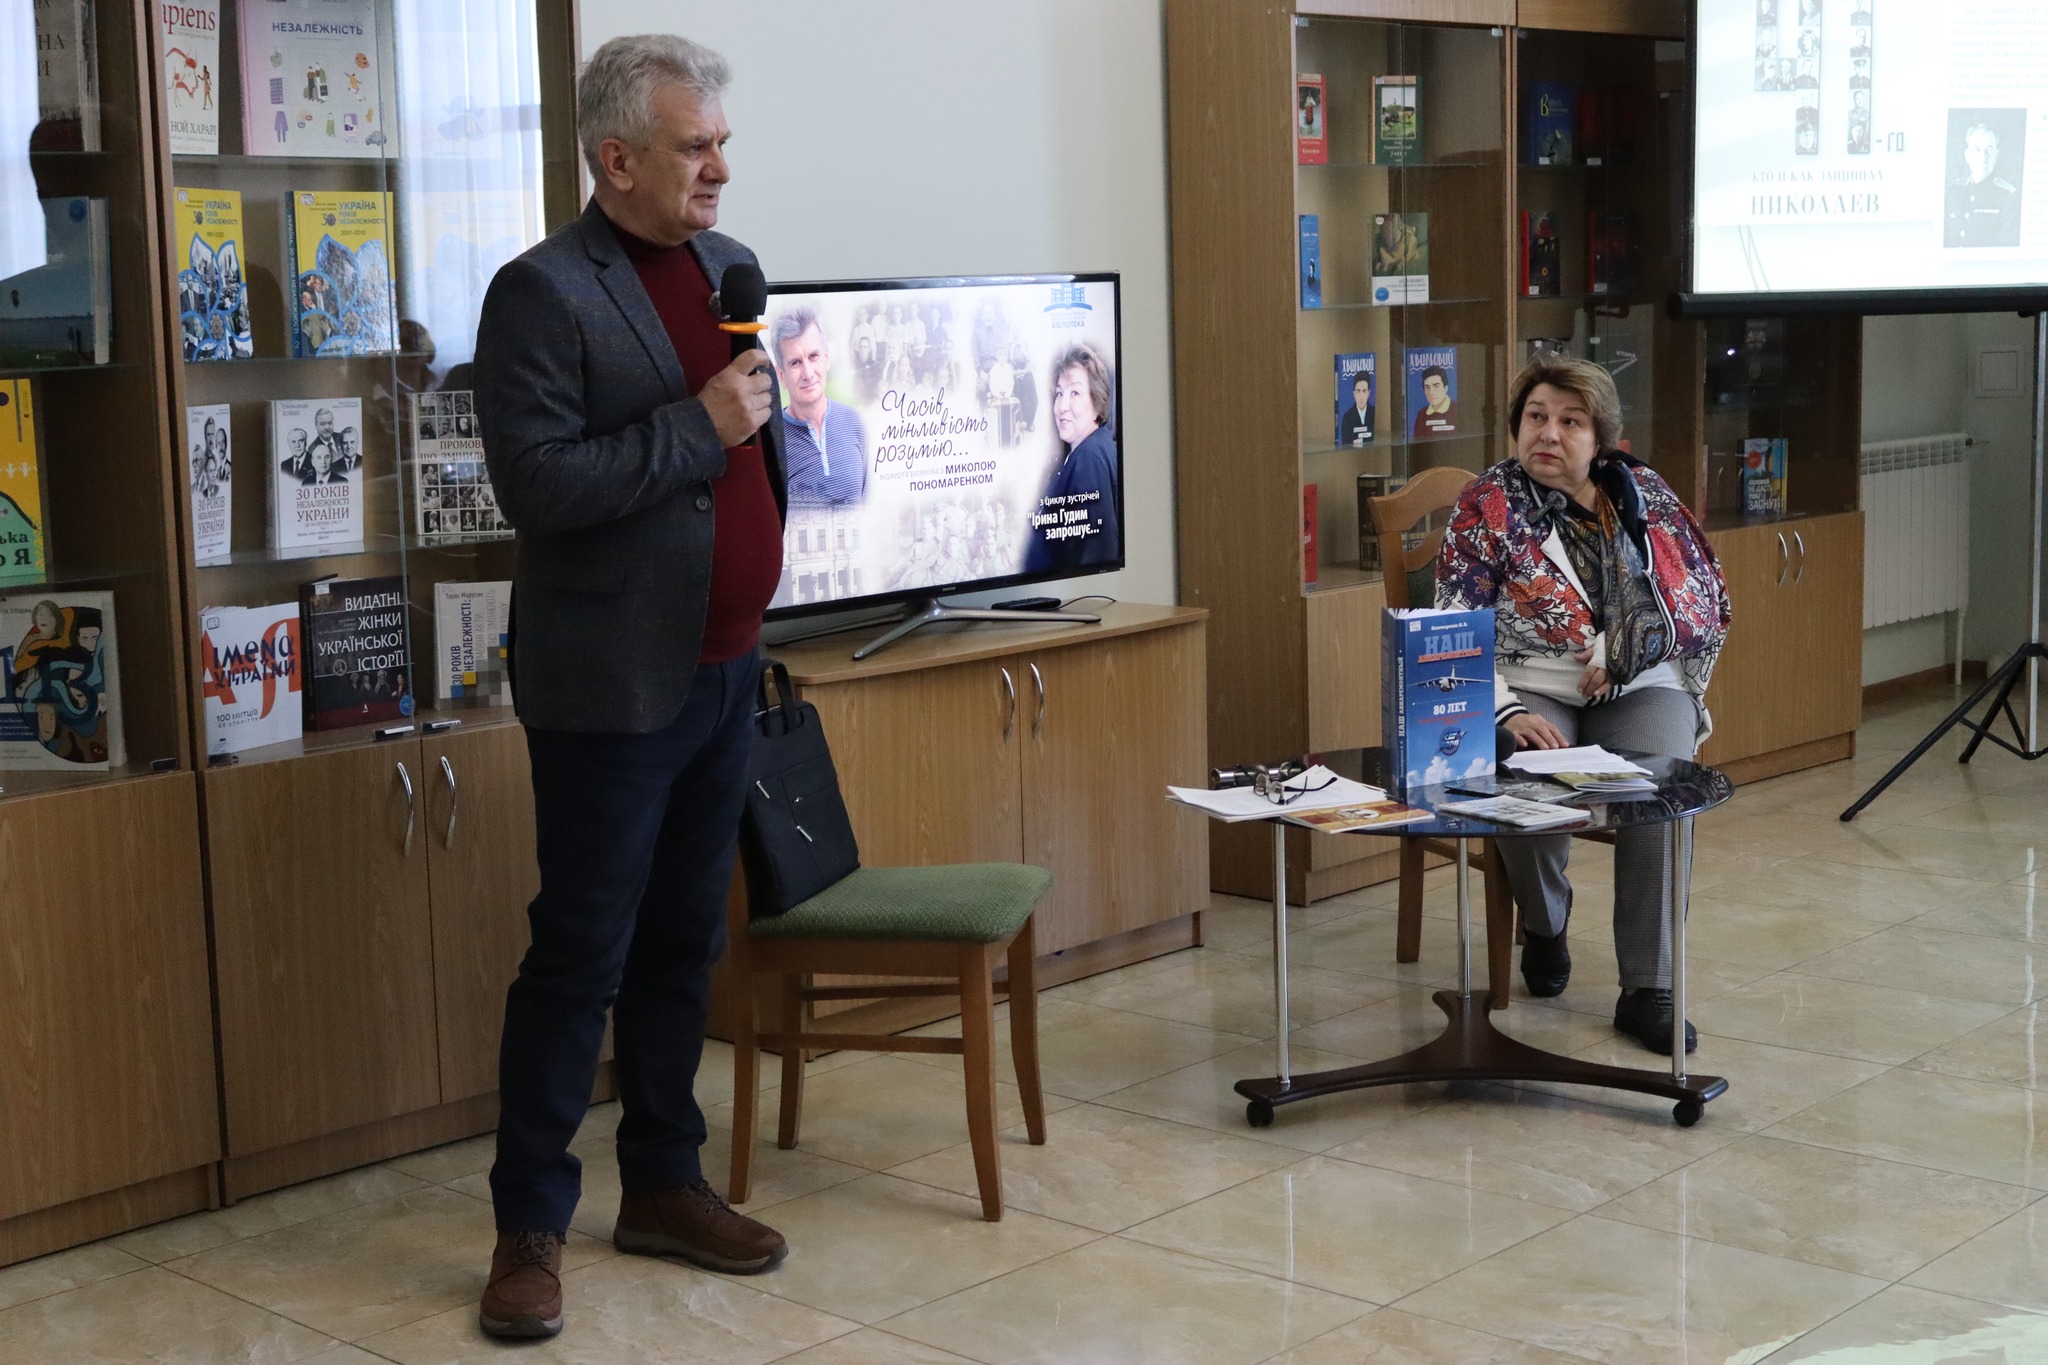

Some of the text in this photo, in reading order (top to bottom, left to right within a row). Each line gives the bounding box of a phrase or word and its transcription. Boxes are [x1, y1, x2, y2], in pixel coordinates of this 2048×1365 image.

[272, 22, 364, 36] НЕЗАЛЕЖНІСТЬ
[339, 199, 377, 210] УКРАЇНА
[1752, 193, 1880, 215] НИКОЛАЕВ
[881, 387, 945, 419] Часів
[881, 408, 988, 440] мінливість
[945, 460, 997, 475] МИКОЛОЮ
[910, 474, 994, 491] ПОНОМАРЕНКОМ
[296, 485, 349, 500] 30 РОКІВ
[1067, 490, 1100, 505] зустрічей
[297, 506, 350, 522] УКРАЇНИ
[1060, 508, 1088, 526] Гудим
[344, 591, 400, 612] ВИДАТНІ
[357, 612, 402, 631] ЖІНКИ
[318, 629, 403, 657] УКРАЇНСЬКОЇ
[461, 599, 475, 672] НЕЗАЛЕЖНОСТІ:
[1424, 631, 1475, 656] НАШ
[357, 649, 405, 671] ІСТОРІЇ
[450, 645, 462, 673] РОКІВ
[216, 713, 231, 722] 100
[1433, 701, 1468, 716] 80 ЛЕТ
